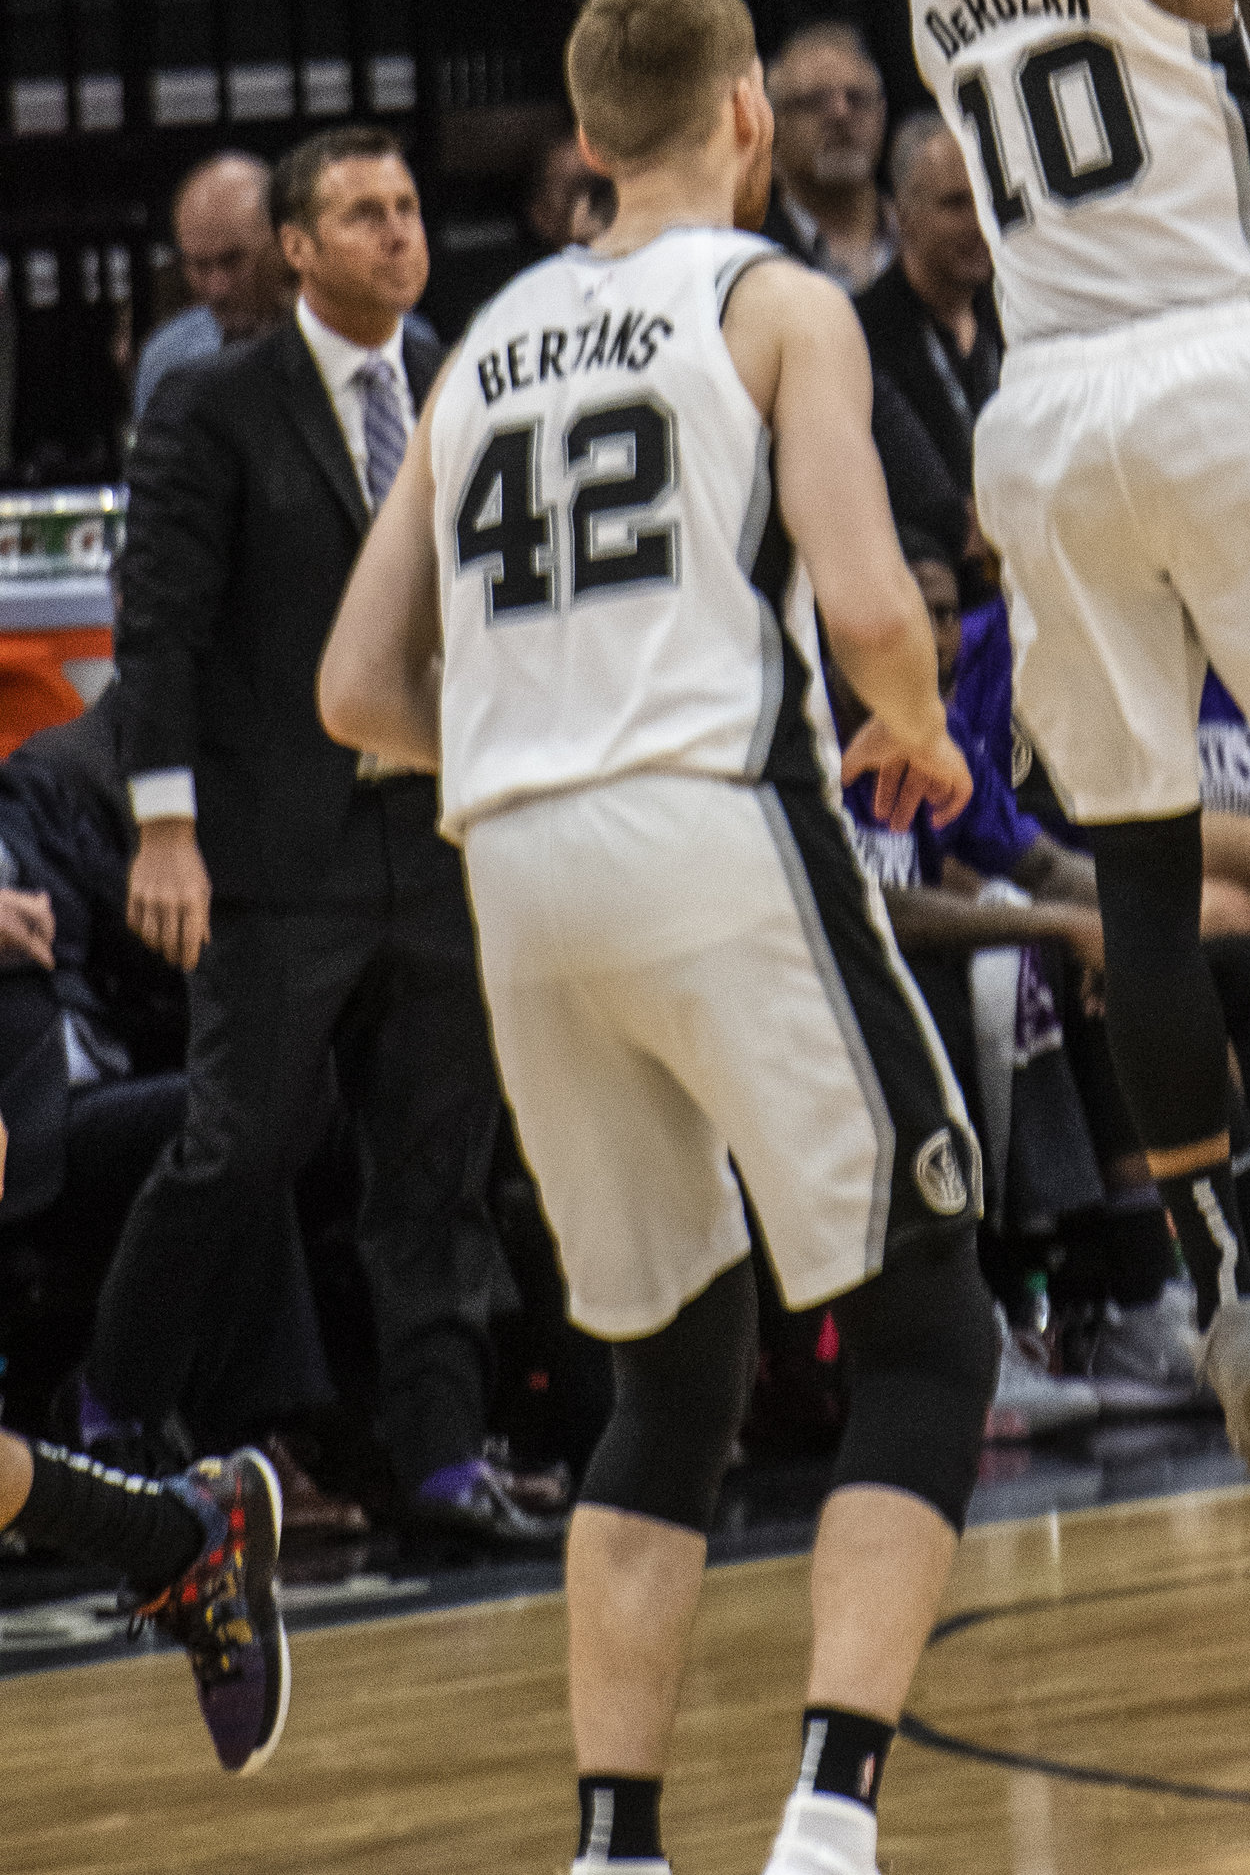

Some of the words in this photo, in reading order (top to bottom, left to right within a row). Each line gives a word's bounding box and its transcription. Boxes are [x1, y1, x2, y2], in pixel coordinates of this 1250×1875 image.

[953, 32, 1151, 235] 10
[477, 308, 674, 407] BERTANS
[453, 388, 682, 625] 42
